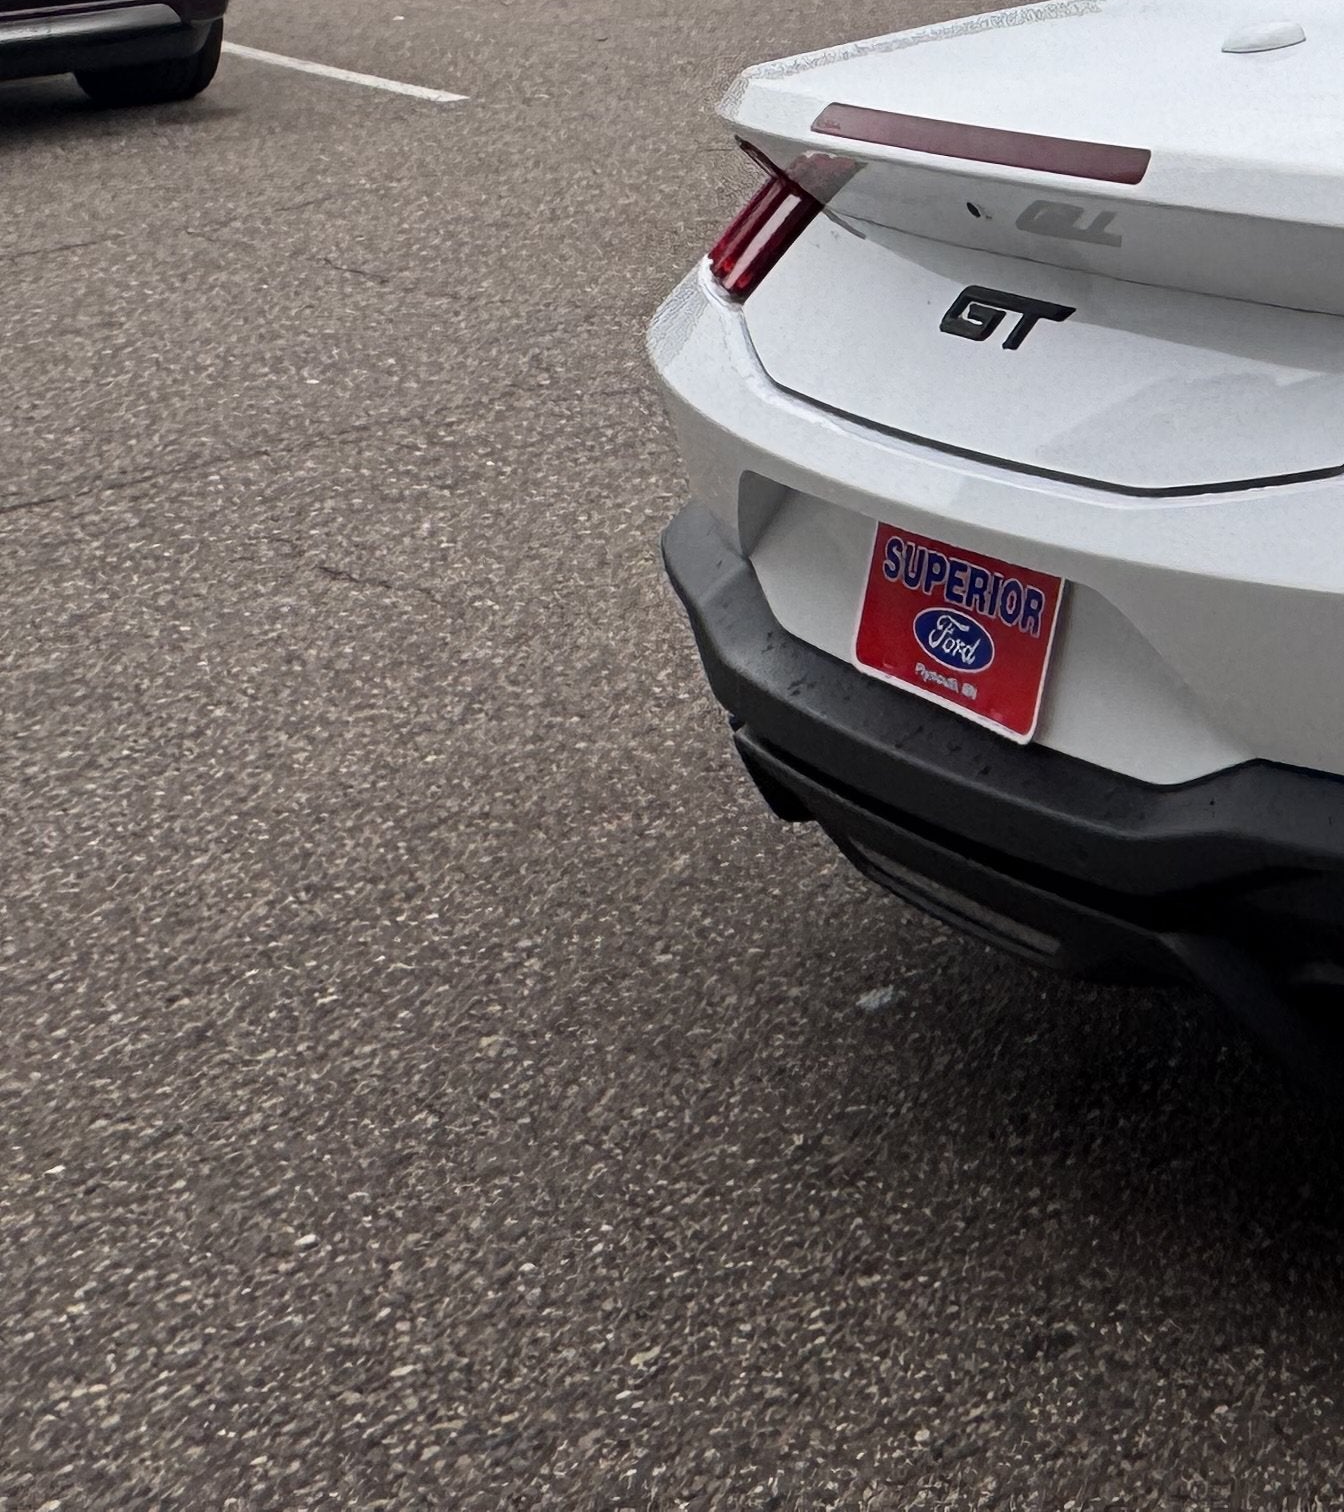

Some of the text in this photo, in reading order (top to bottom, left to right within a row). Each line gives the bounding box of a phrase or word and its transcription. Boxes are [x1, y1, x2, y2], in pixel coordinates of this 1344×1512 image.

[940, 285, 1077, 350] GT
[883, 535, 1045, 637] SUPERIOR
[928, 614, 981, 665] Ford
